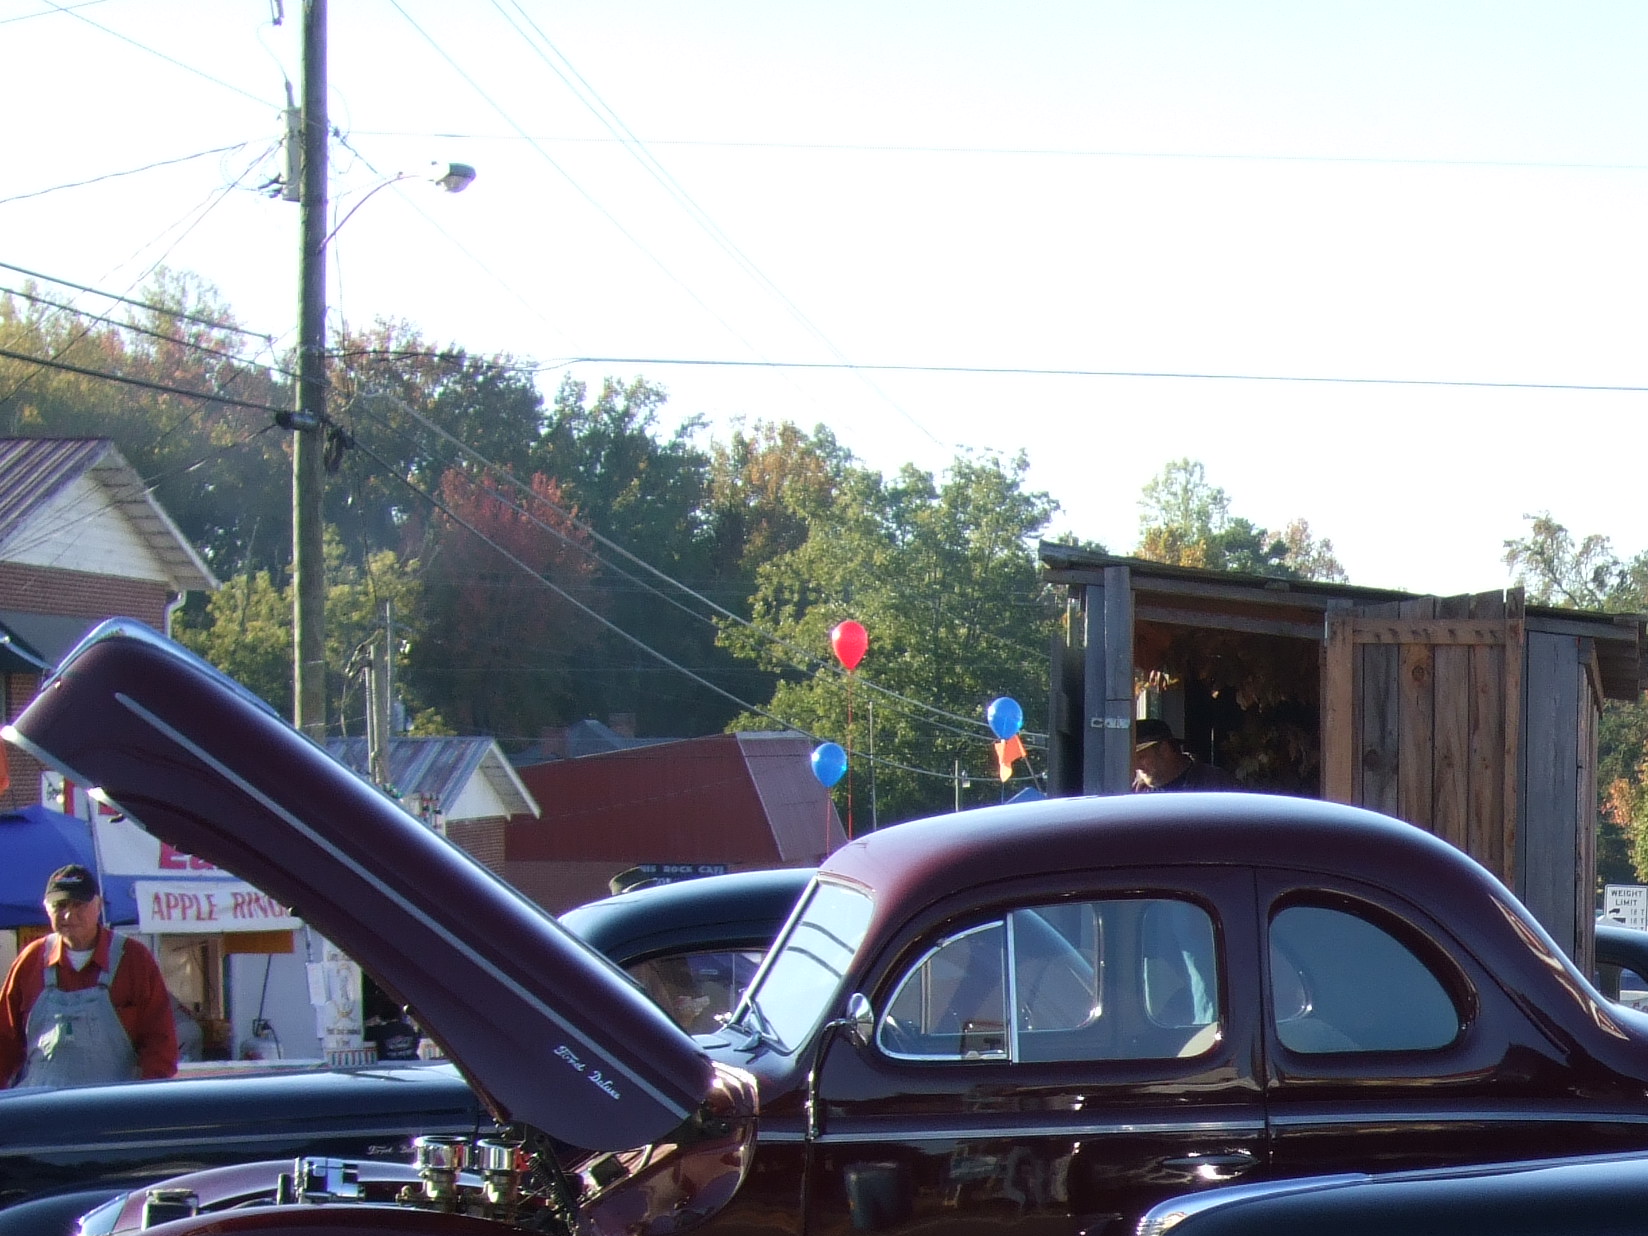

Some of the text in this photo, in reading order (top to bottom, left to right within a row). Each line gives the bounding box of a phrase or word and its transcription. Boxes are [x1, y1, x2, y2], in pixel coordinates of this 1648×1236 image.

[1611, 889, 1643, 898] WEIGHT
[1615, 899, 1638, 907] LIMIT
[151, 891, 219, 922] APPLE
[552, 1044, 587, 1074] Ford
